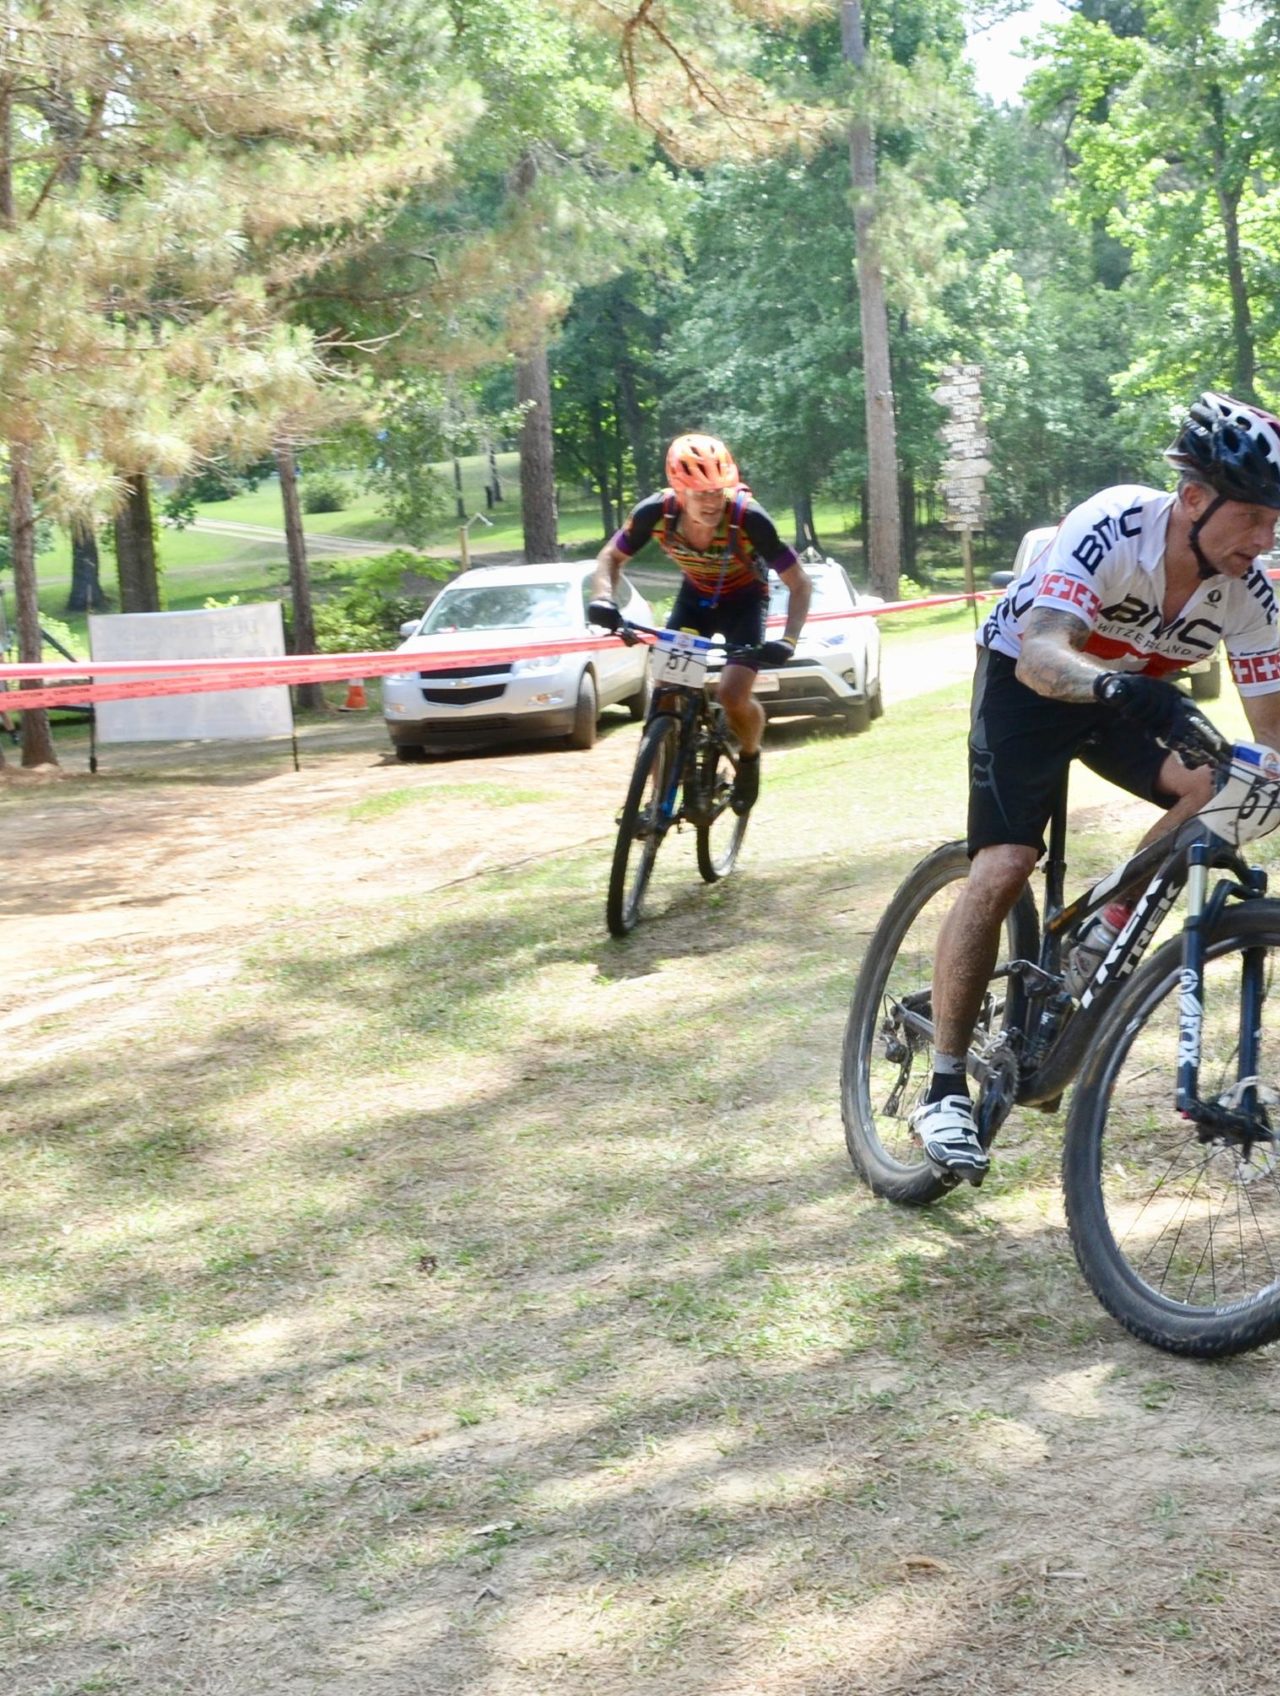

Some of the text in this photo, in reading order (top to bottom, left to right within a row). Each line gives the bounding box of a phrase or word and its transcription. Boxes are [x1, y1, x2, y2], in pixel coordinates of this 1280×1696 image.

[1072, 506, 1143, 576] BMC
[1099, 593, 1221, 650] BMC
[1114, 881, 1182, 979] TREK
[1177, 1014, 1203, 1067] FOX
